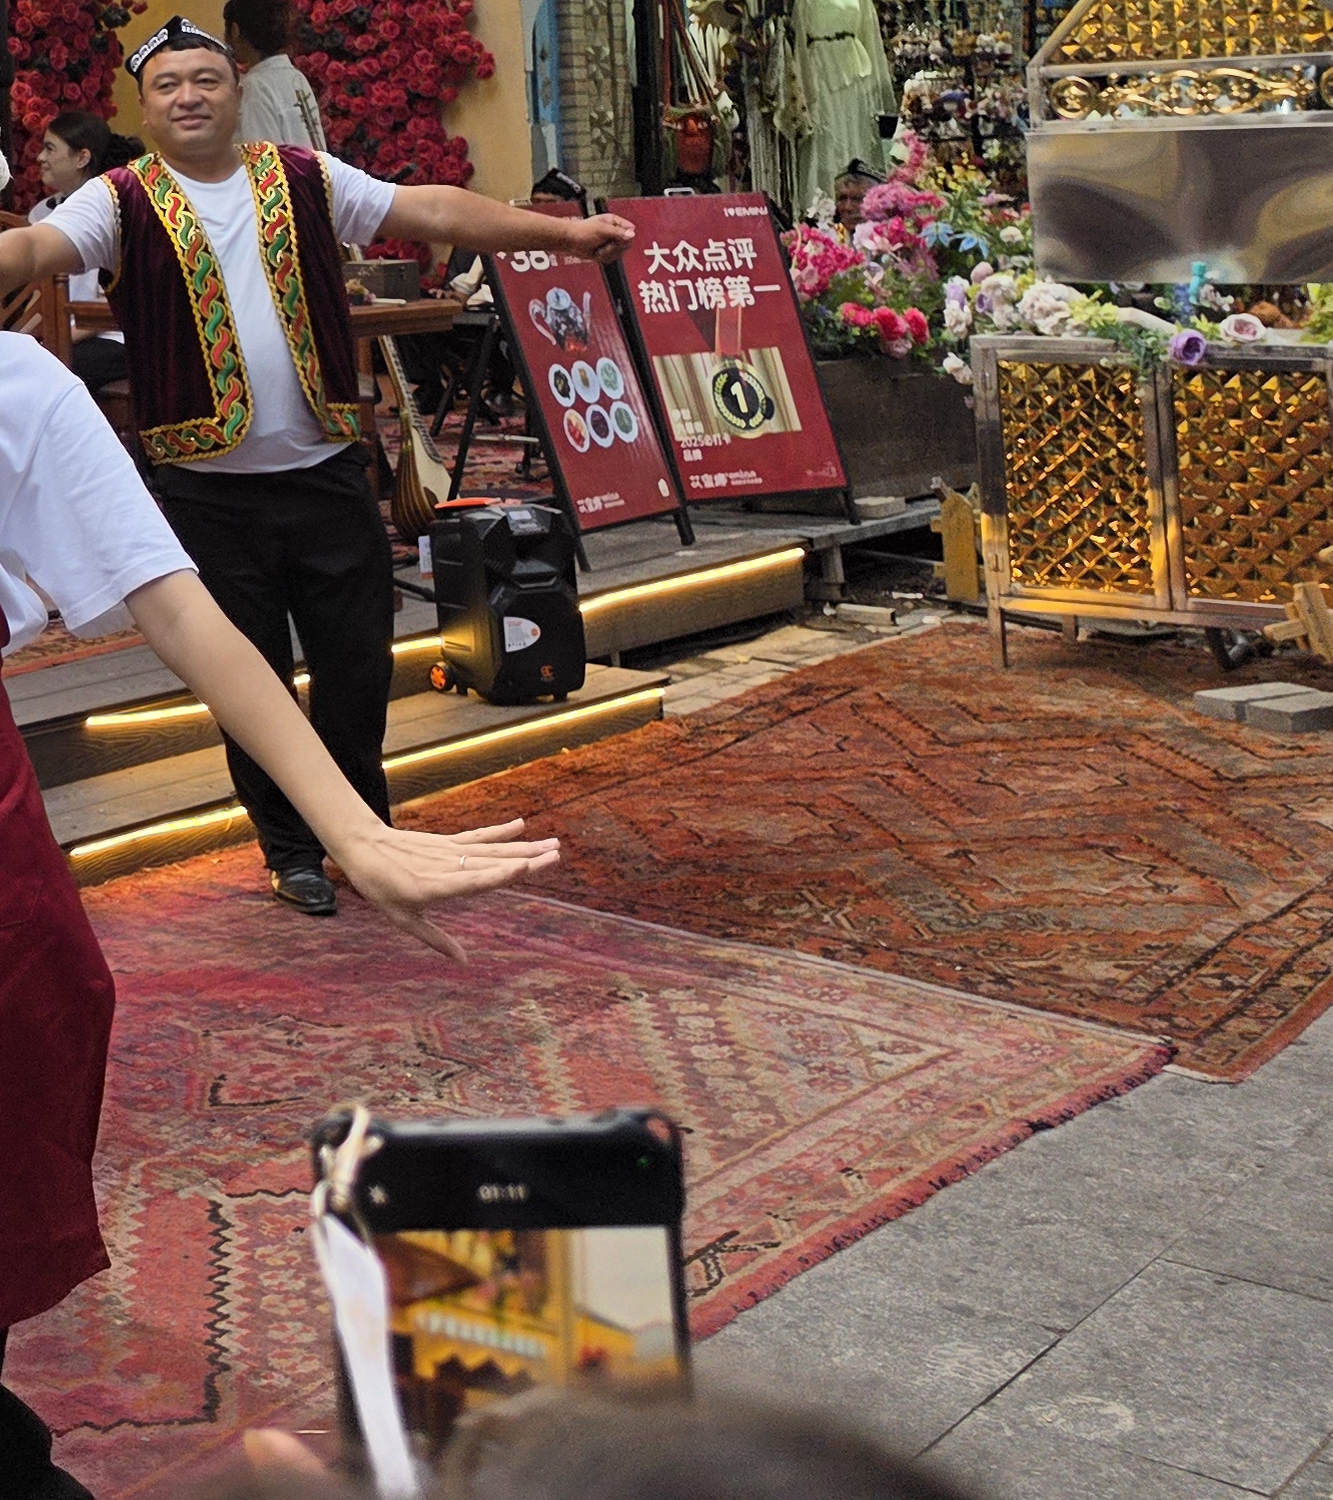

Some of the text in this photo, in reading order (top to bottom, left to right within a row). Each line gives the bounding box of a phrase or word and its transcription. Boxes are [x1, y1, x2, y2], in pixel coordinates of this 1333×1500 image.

[644, 238, 757, 274] 大众点评
[638, 275, 781, 313] 热门榜第一
